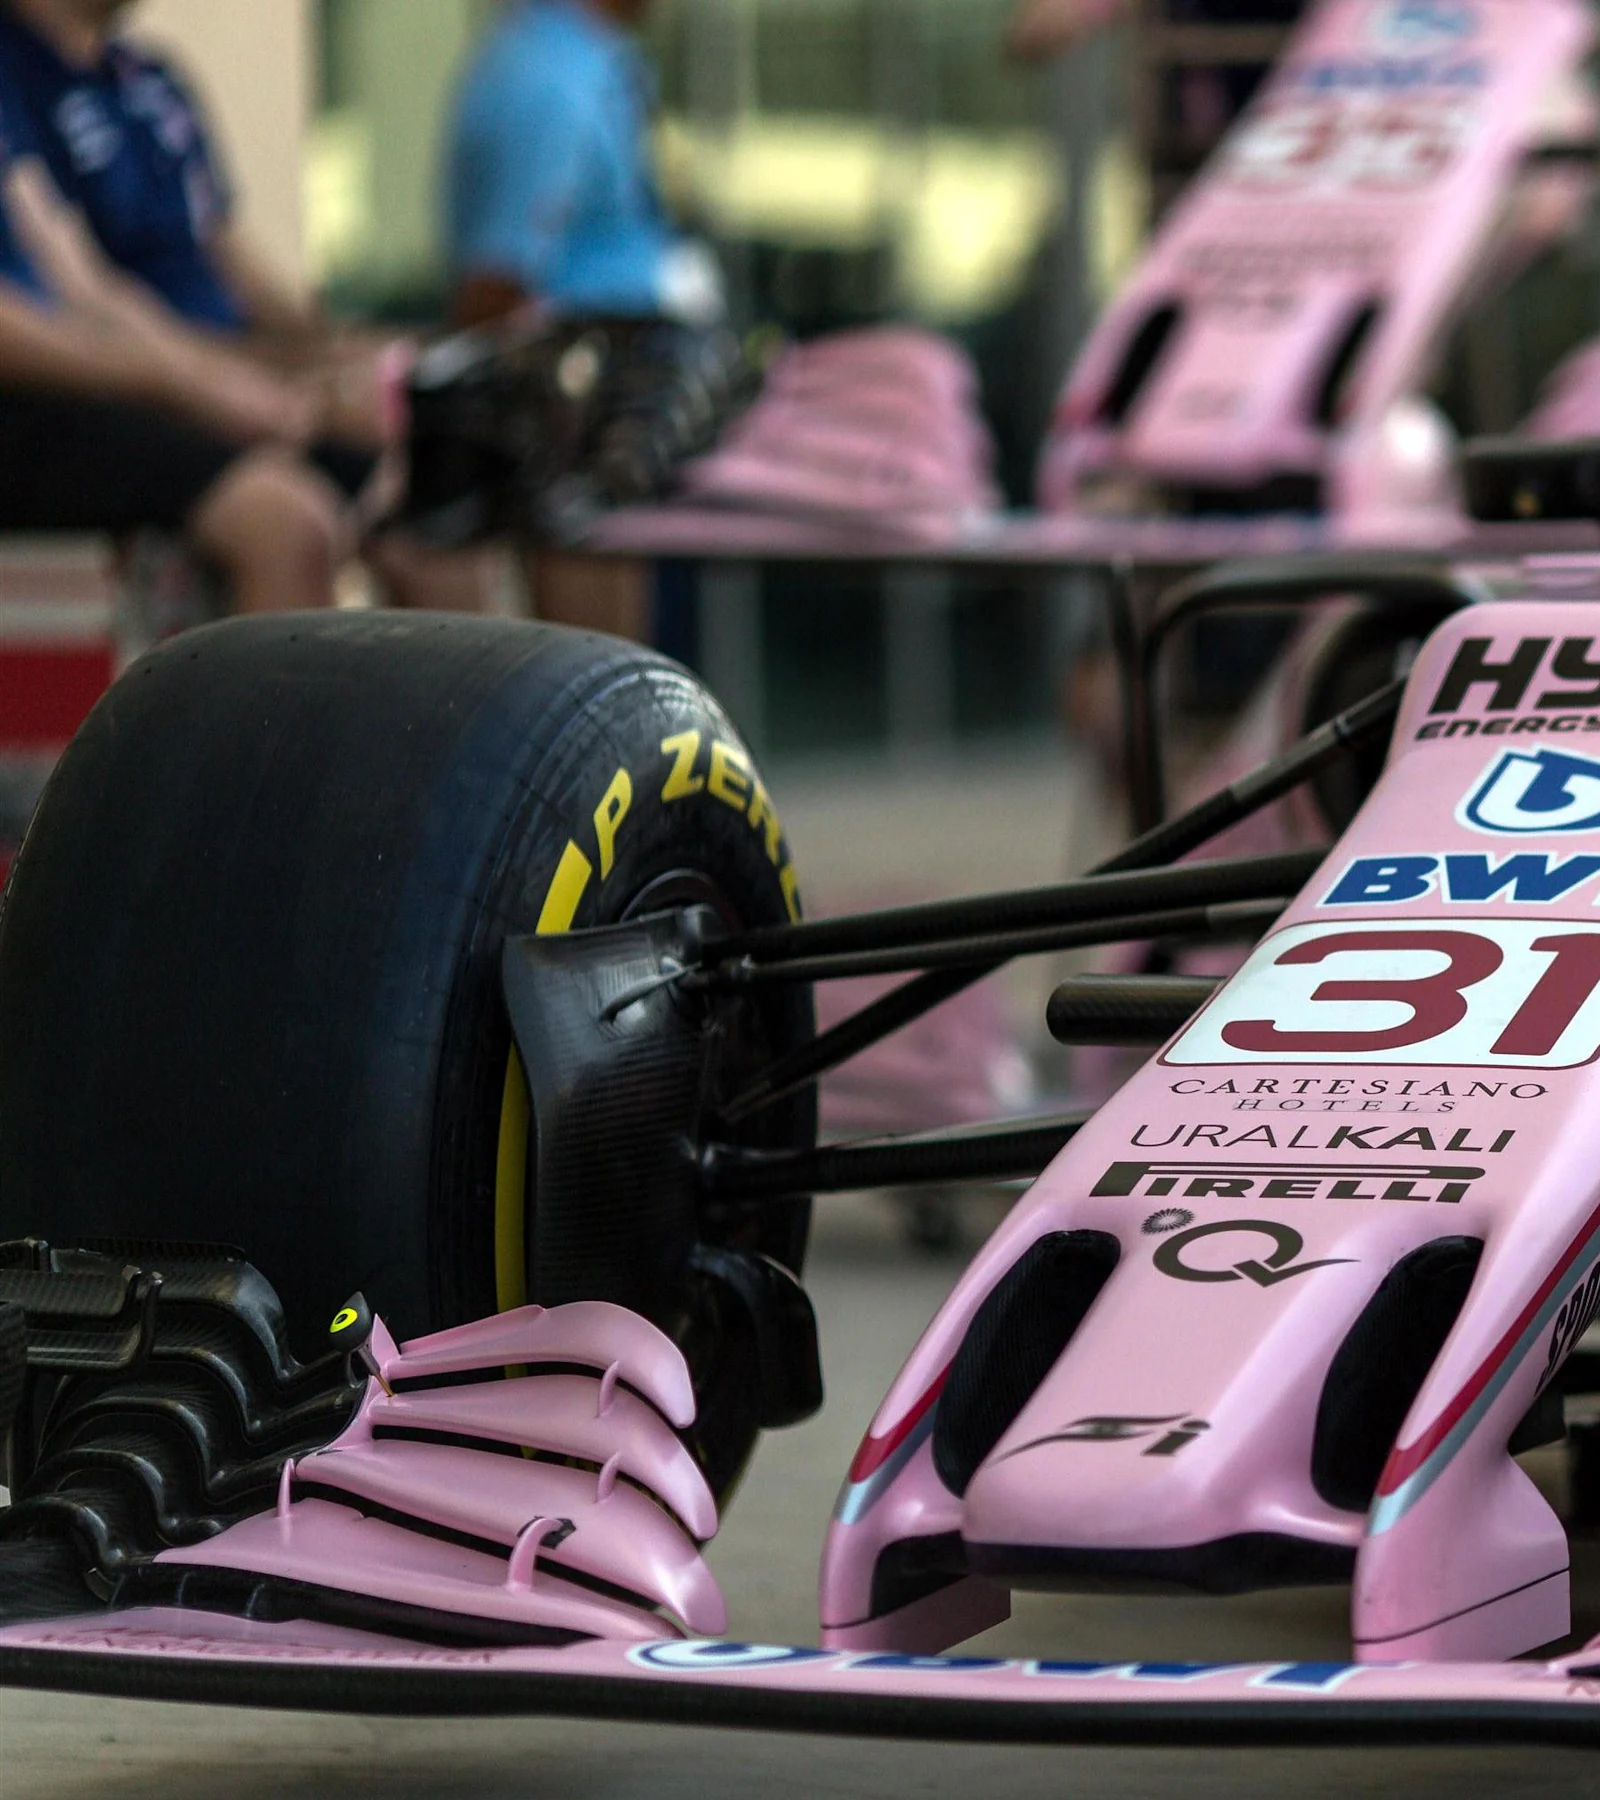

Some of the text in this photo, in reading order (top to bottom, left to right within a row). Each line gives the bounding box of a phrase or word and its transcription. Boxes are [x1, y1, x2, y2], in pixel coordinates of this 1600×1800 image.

[594, 767, 633, 882] P
[1168, 1078, 1549, 1099] CARTESIANO
[1235, 1099, 1456, 1113] HOTELS
[1130, 1123, 1517, 1153] URALKALI
[1089, 1160, 1487, 1203] PIRELLI
